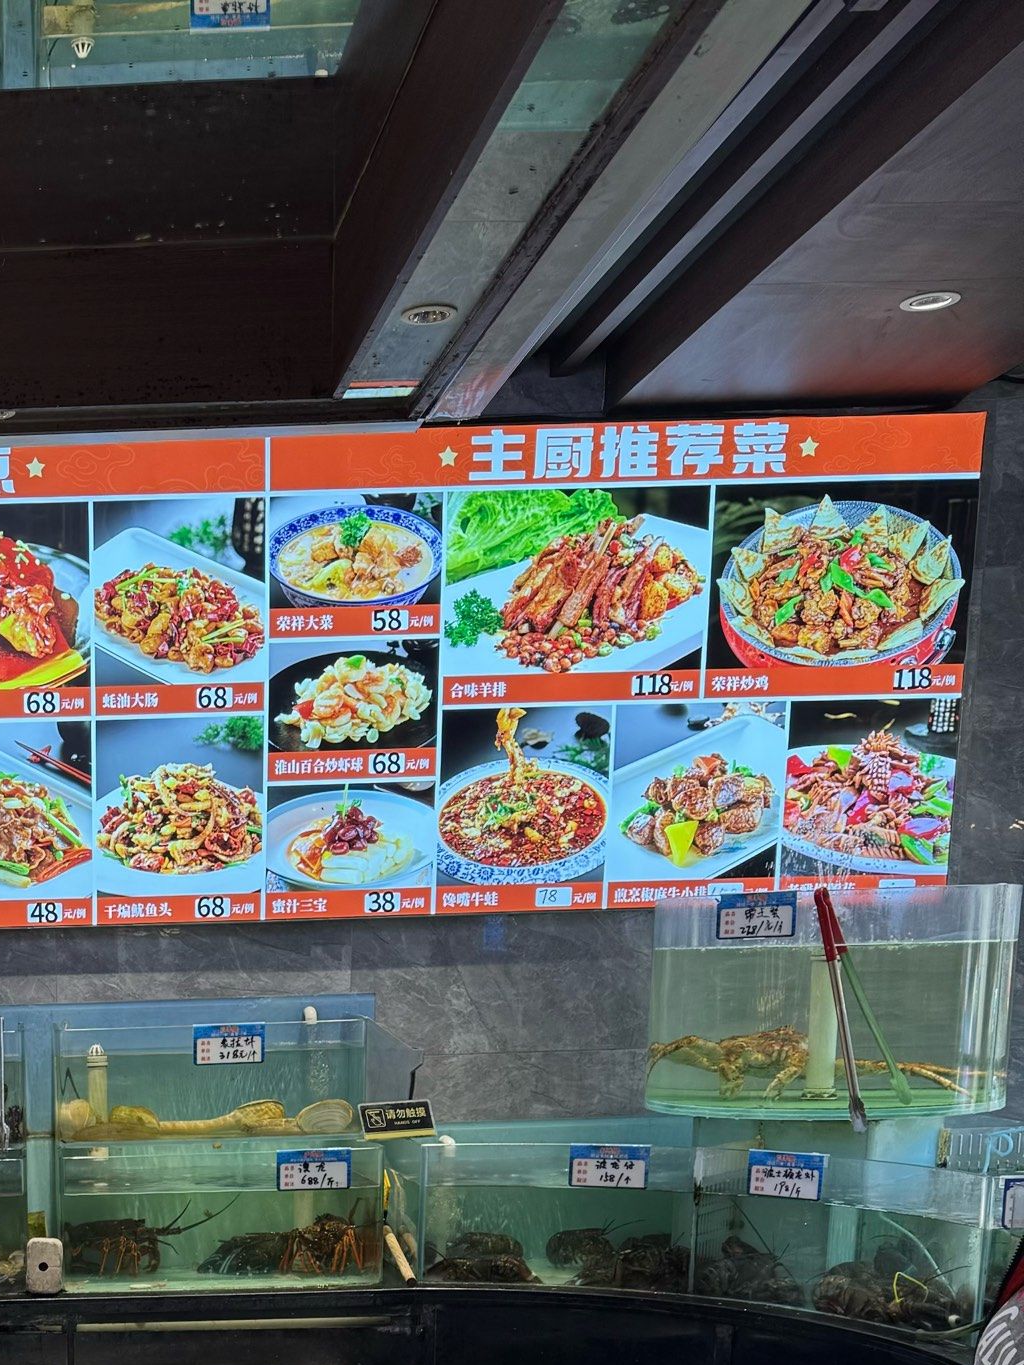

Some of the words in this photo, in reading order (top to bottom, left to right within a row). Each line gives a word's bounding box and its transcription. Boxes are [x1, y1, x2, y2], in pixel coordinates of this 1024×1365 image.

[468, 422, 791, 481] 主厨推荐菜
[276, 614, 334, 632] 荣祥大菜
[373, 608, 402, 632] 58
[450, 681, 507, 699] 合味羊排
[634, 673, 673, 697] 118
[711, 674, 769, 692] 荣祥炒鸡
[892, 666, 933, 691] 118
[26, 691, 56, 714] 68
[102, 691, 159, 709] 蚝油大肠
[198, 686, 227, 709] 68
[373, 752, 401, 774] 68
[30, 902, 58, 923] 48
[197, 895, 225, 918] 68
[271, 897, 328, 914] 蜜汁三宝
[368, 891, 395, 913] 38
[386, 1107, 427, 1120] 请勿触摸
